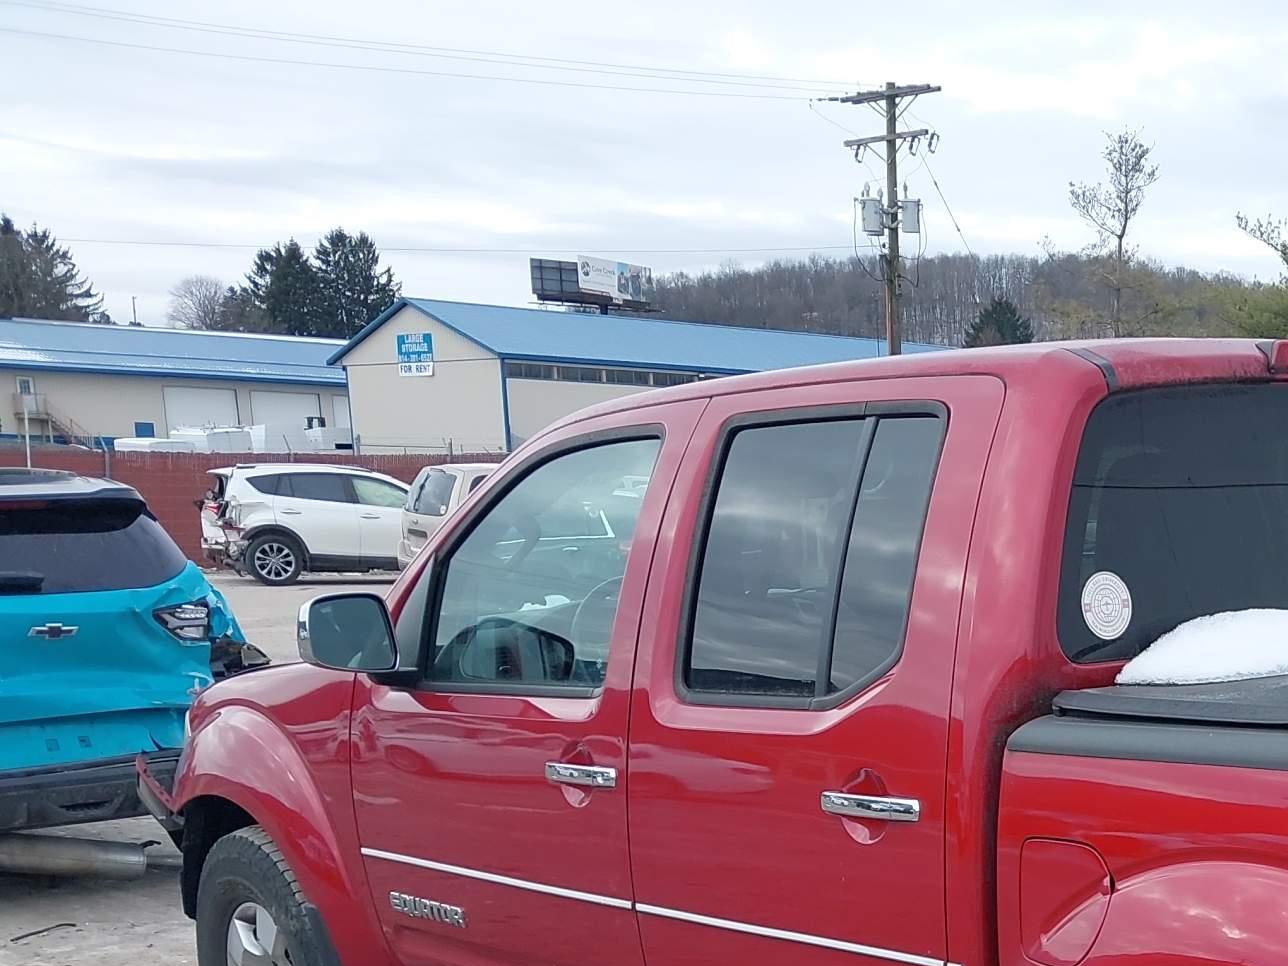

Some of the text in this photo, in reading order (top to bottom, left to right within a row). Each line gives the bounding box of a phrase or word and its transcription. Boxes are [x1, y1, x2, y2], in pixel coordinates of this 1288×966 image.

[404, 334, 424, 343] LARGE
[401, 343, 429, 352] STORAGE
[400, 364, 431, 374] FOR RENT
[389, 890, 466, 928] EQUATOR
